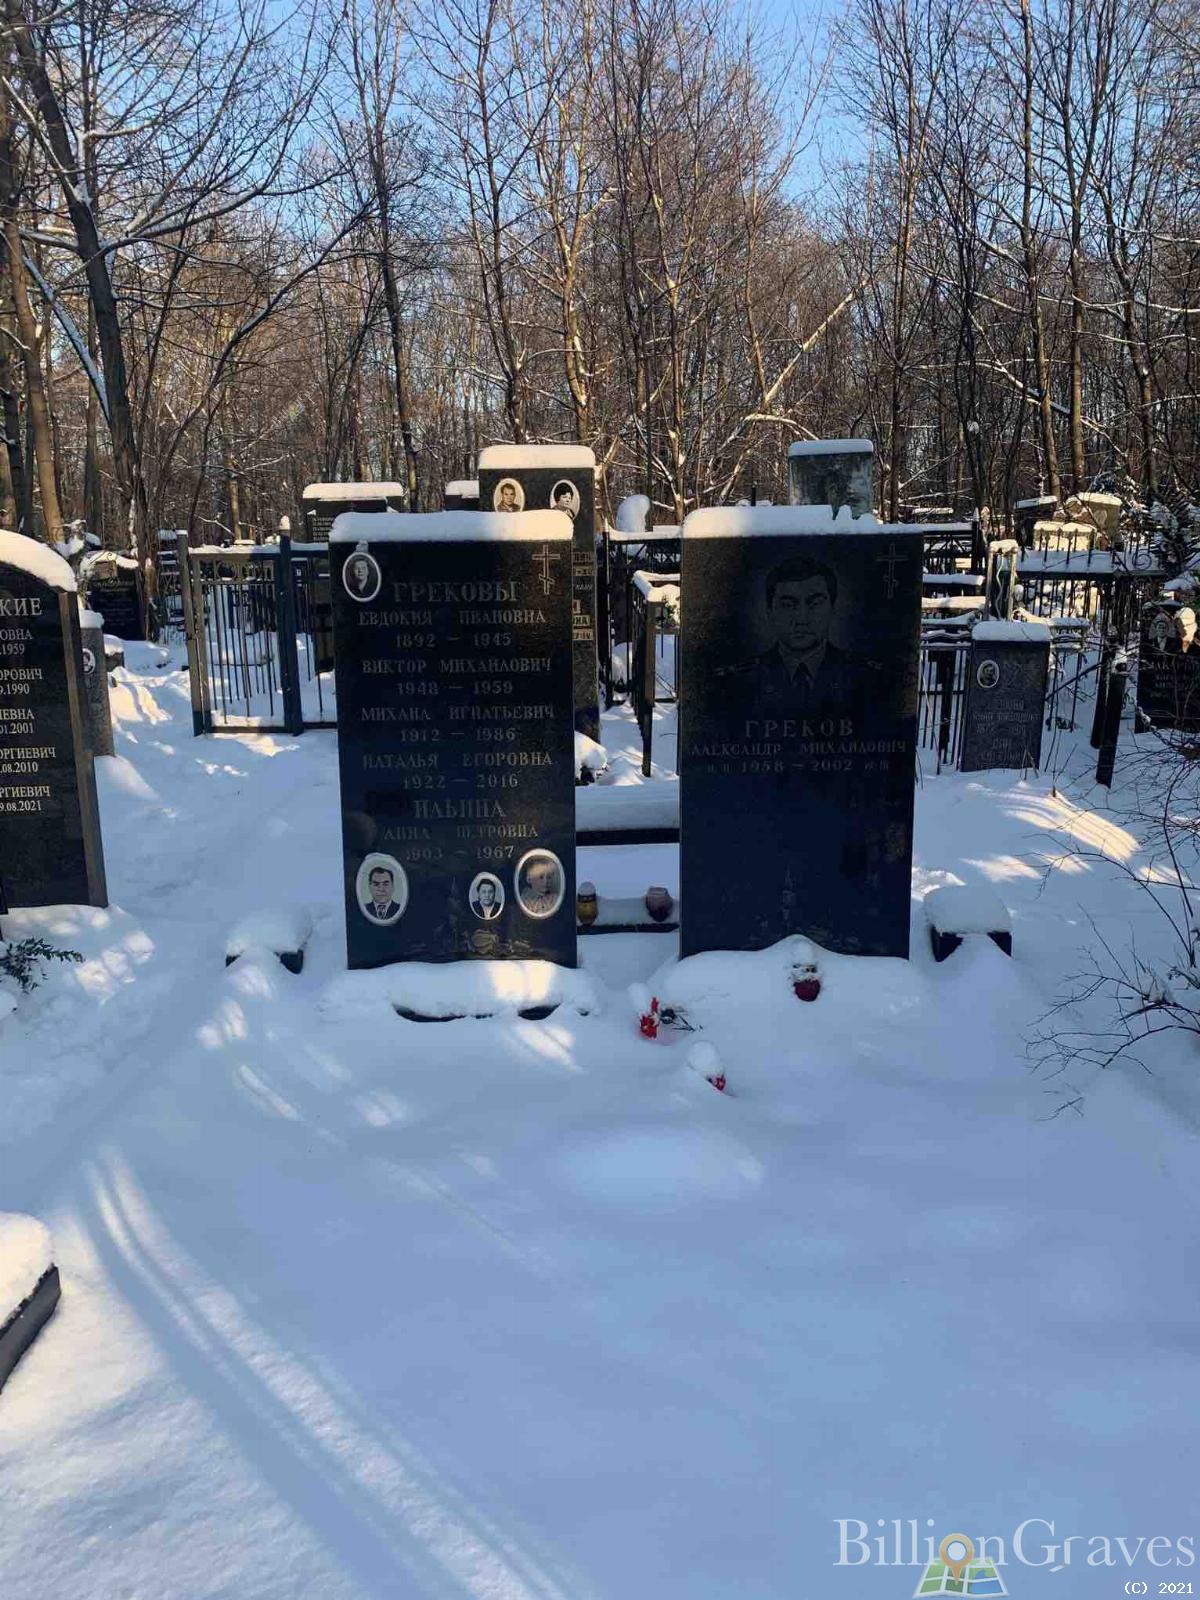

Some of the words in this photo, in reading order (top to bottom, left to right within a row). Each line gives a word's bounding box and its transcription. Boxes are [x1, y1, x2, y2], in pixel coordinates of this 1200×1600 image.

[393, 580, 522, 602] ГРЕКОВЫ
[358, 610, 433, 626] ЕВДОКИЯ
[457, 609, 546, 624] ИВАНОВНА
[396, 633, 437, 648] 1892
[473, 632, 512, 647] 1945
[362, 659, 428, 674] ВИКТОР
[397, 682, 440, 696] 1948
[473, 680, 514, 695] 1959
[361, 707, 433, 721] МИХАИЛ
[448, 705, 555, 720] ИГНАТЬЕВИЧ
[400, 729, 440, 743] 1912
[476, 728, 517, 742] 1986
[744, 719, 854, 738] ГРЕКОВ
[691, 742, 783, 757] АЛЕКСАНДР
[362, 753, 440, 769] НАТАЛЬЯ
[462, 752, 553, 768] ЕГОРОВНА
[741, 760, 785, 773] 1958
[810, 759, 854, 772] 2002
[403, 774, 447, 790] 1922
[476, 773, 519, 789] 2016
[413, 799, 507, 819] ИЛЬИНА
[384, 826, 433, 840] АННА
[456, 825, 539, 840] ПЕТРОВНА
[475, 844, 515, 860] 1967
